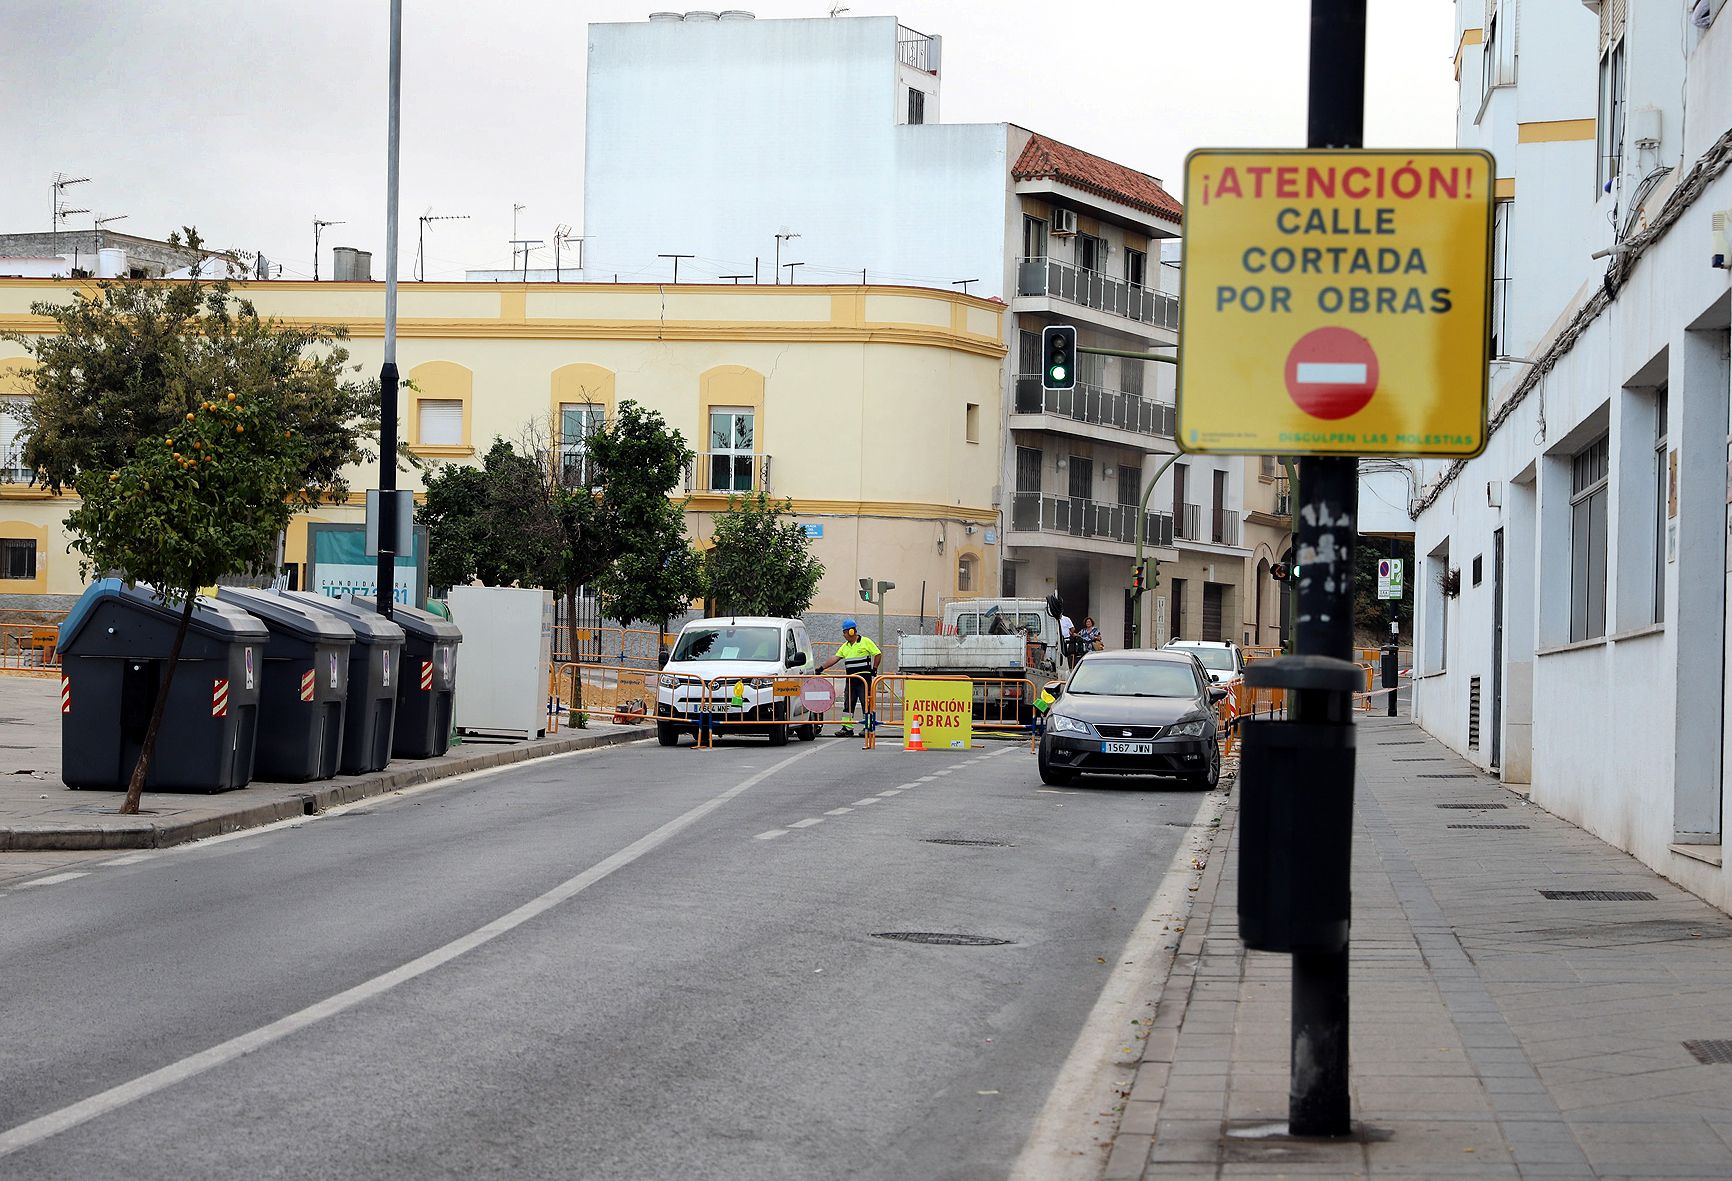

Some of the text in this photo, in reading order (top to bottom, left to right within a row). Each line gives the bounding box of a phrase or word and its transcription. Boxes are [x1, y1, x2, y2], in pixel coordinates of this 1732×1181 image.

[1202, 160, 1473, 206] ¡ATENCIÓN!
[1276, 207, 1396, 235] CALLE
[1242, 246, 1427, 274] CORTADA
[1215, 286, 1453, 314] POR OBRAS
[1279, 432, 1473, 445] DISCULPEN LAS MOLESTIAS
[322, 580, 407, 588] CANDIDARA
[1108, 743, 1130, 753] 1567
